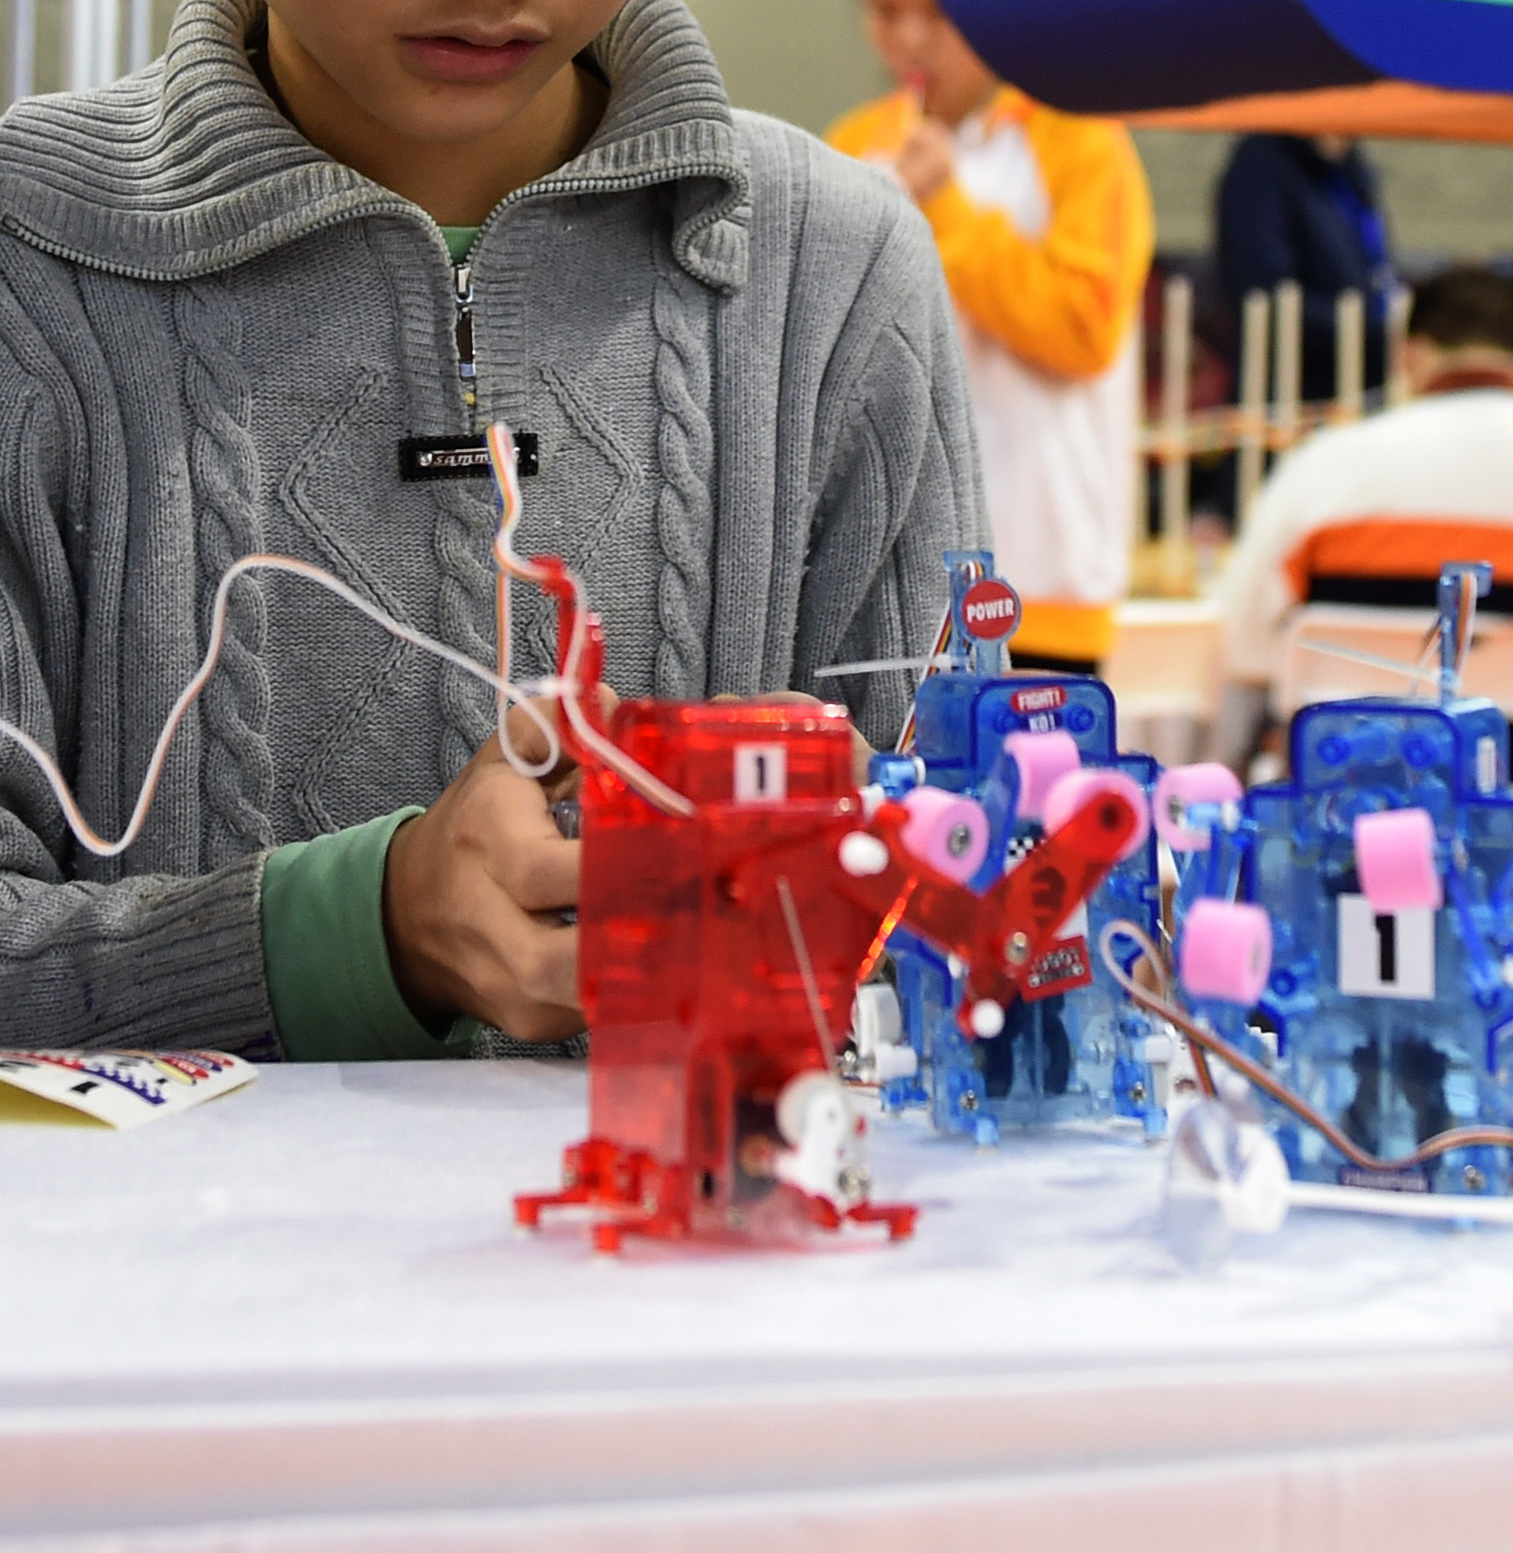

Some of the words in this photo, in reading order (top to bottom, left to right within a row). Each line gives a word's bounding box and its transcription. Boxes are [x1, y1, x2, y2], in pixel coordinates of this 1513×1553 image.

[966, 597, 1015, 624] POWER
[754, 753, 768, 793] 1
[1373, 913, 1397, 985] 1
